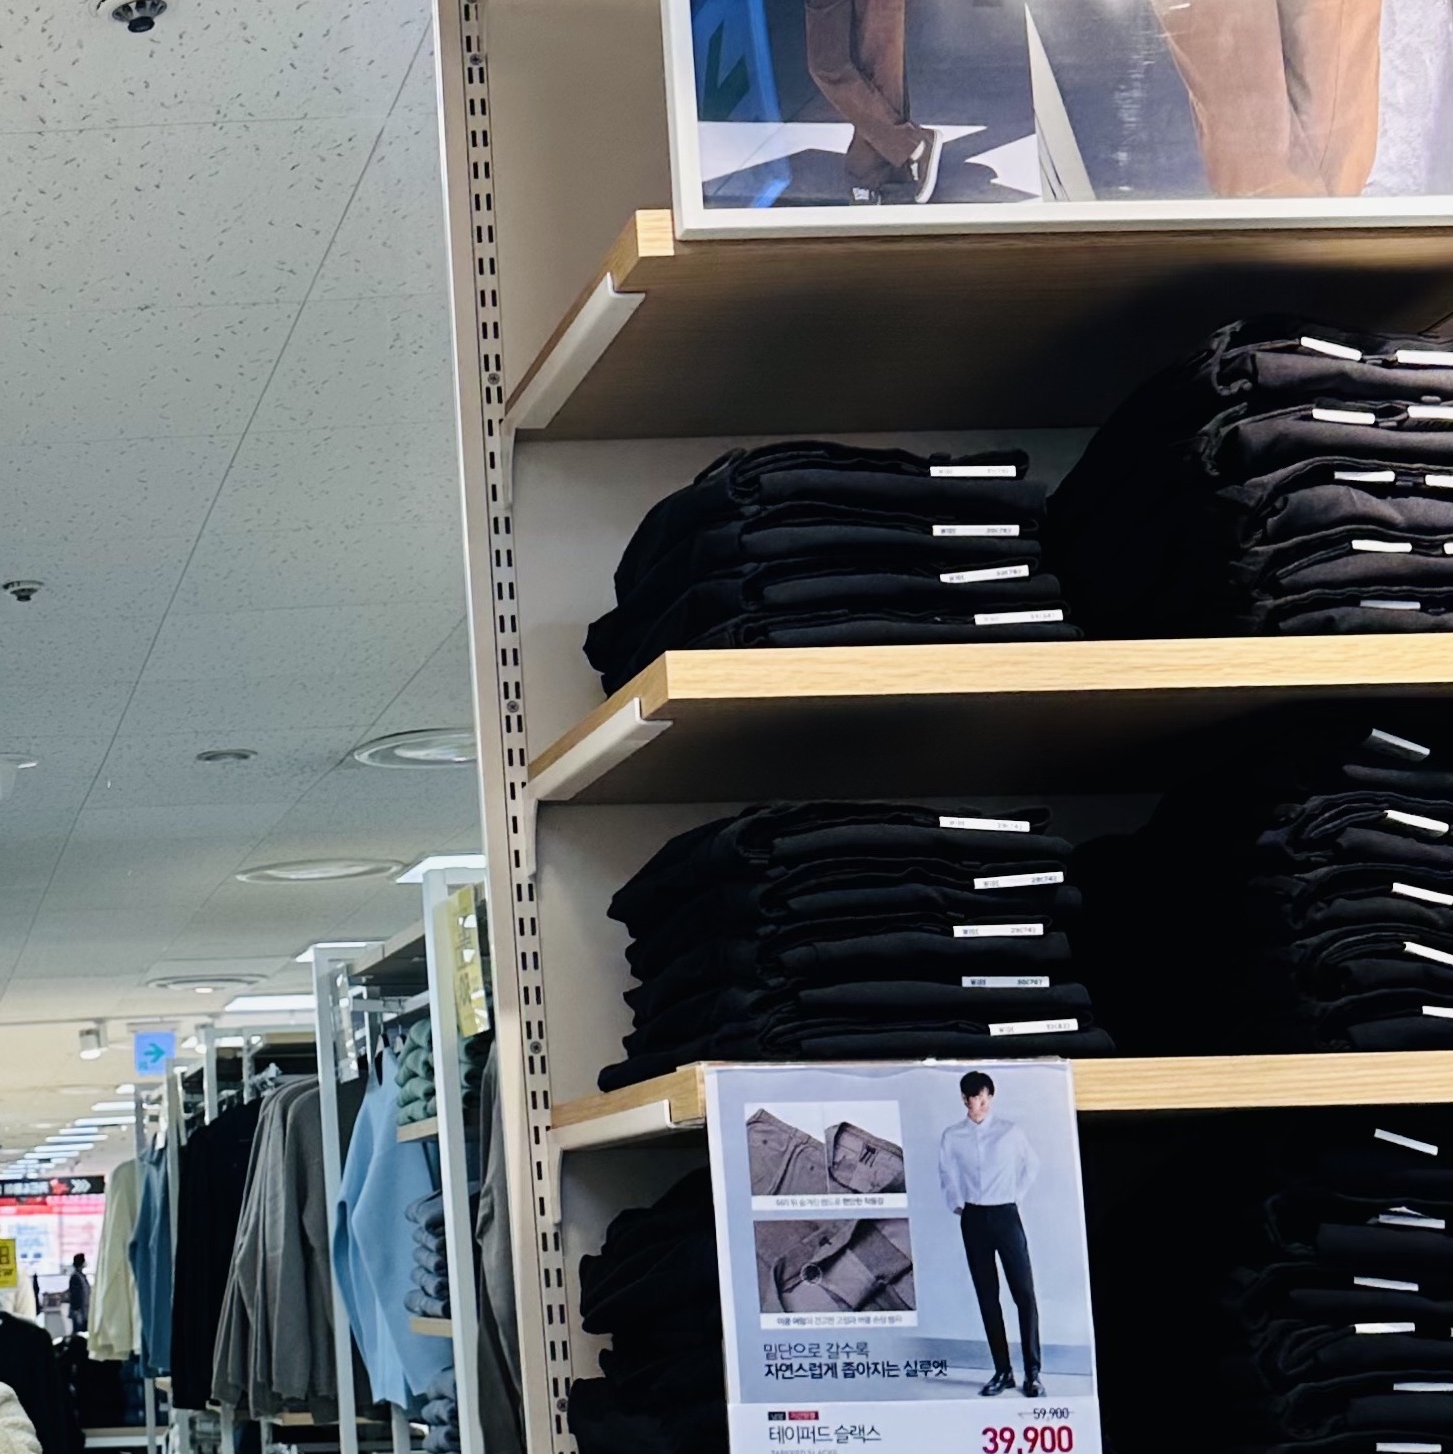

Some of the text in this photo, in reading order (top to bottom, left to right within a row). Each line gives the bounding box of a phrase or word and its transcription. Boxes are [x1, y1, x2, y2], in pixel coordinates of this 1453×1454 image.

[764, 1341, 870, 1360] 밑단으로 갈수록
[764, 1359, 947, 1380] 자연스럽게 좁아지는 실루엣
[1033, 1407, 1069, 1421] 59,900
[769, 1424, 881, 1444] 테이퍼드 슬랙스
